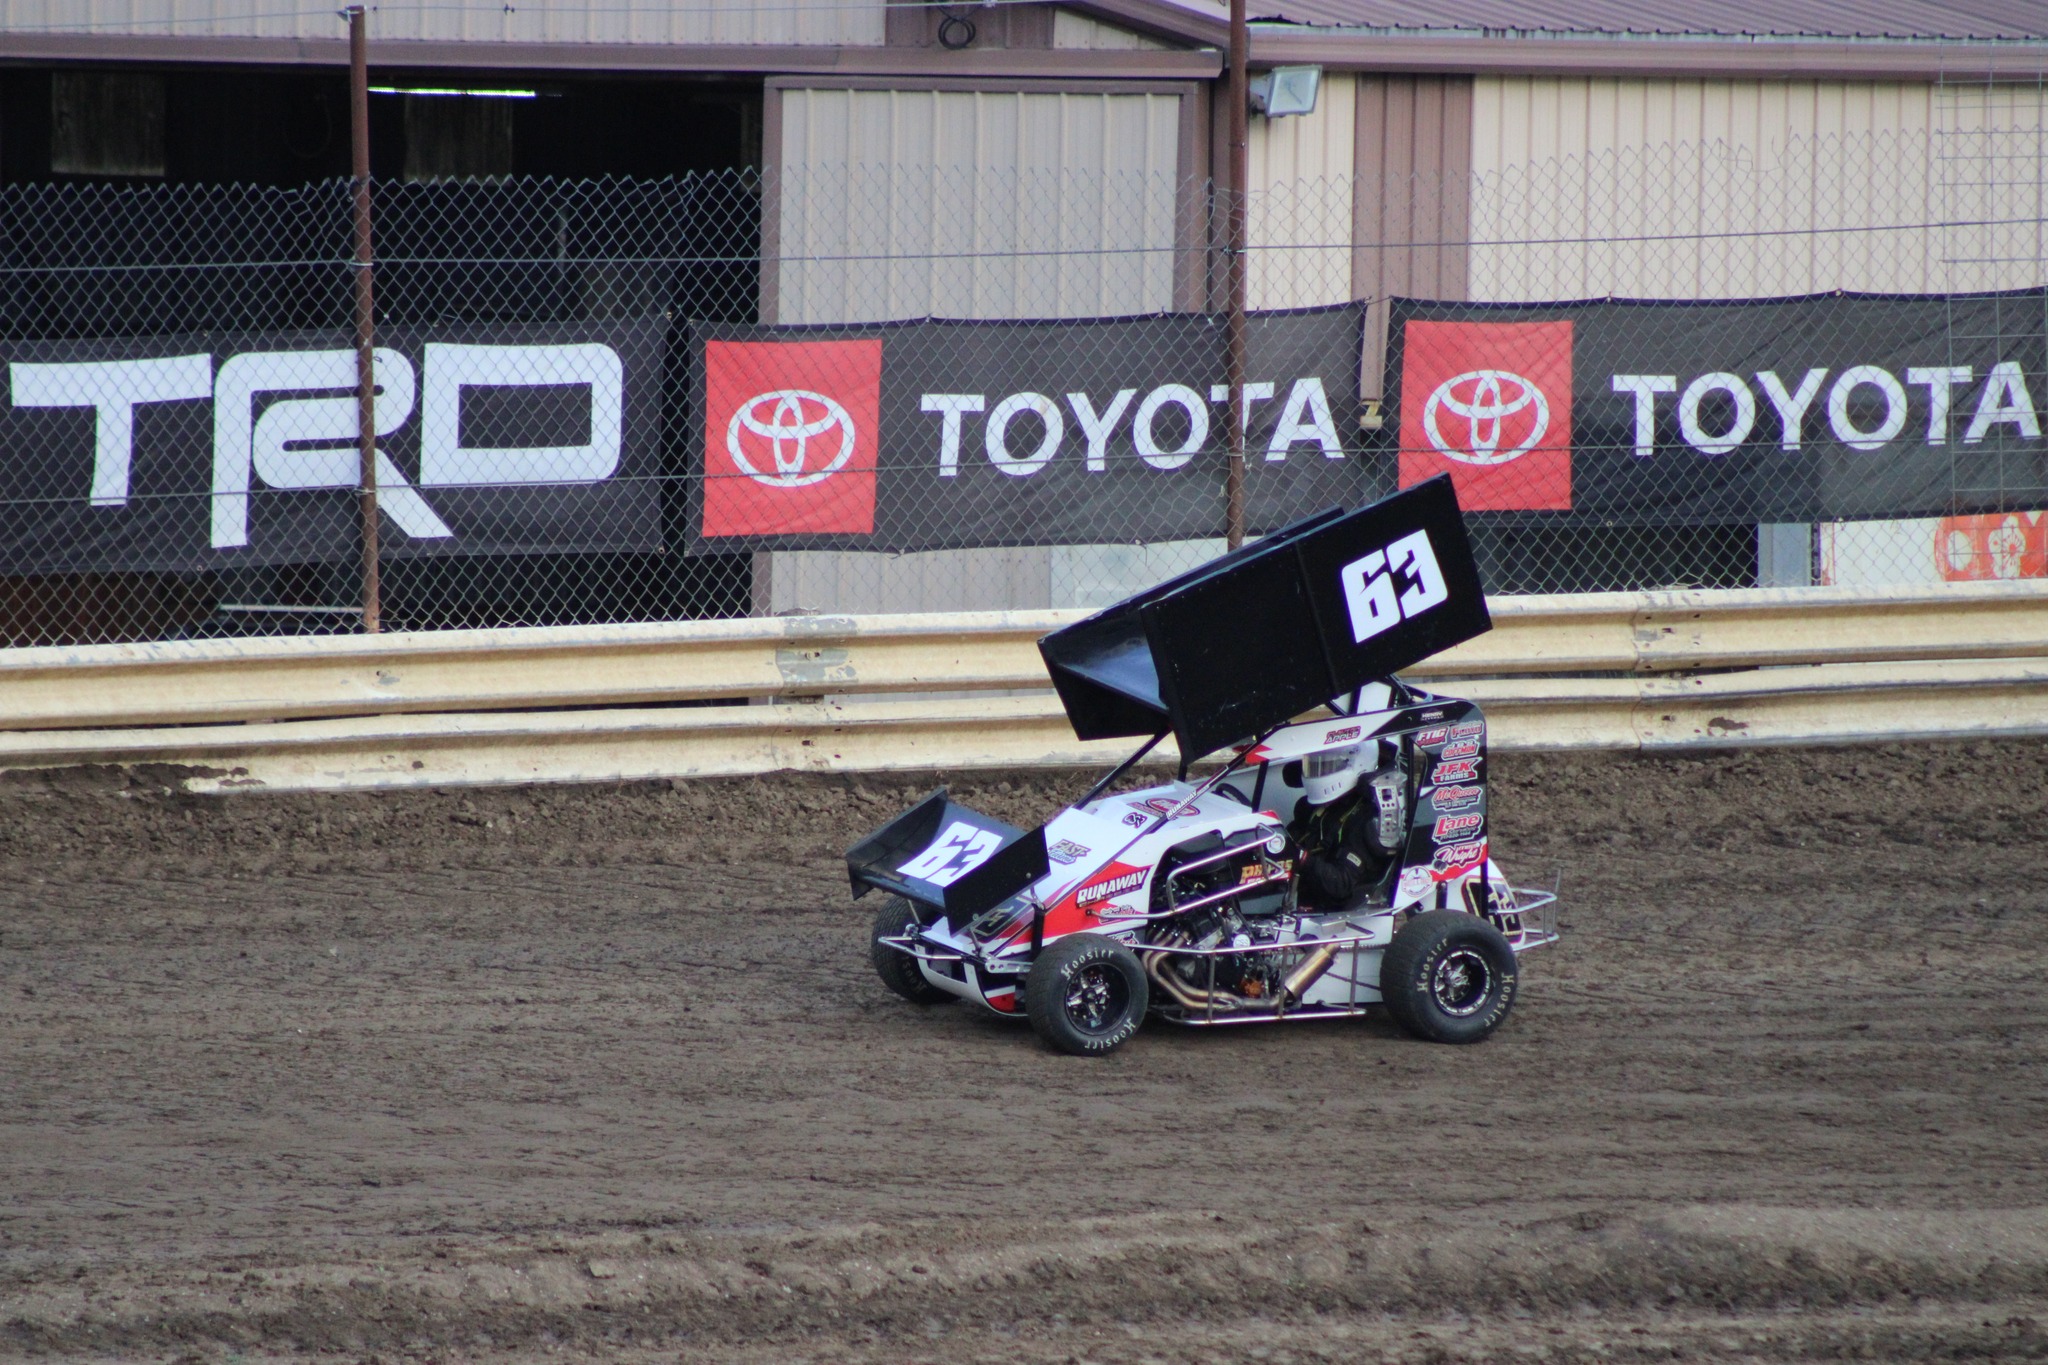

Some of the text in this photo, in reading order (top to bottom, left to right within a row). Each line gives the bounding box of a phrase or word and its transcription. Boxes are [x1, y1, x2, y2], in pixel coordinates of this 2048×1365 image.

[1612, 361, 2042, 456] TOYOTA
[921, 377, 1345, 477] TOYOTA
[10, 342, 623, 548] TRD
[1341, 528, 1448, 643] 63
[1435, 761, 1472, 777] JFK
[1439, 772, 1469, 782] FARMS
[1165, 791, 1197, 818] RUNAWAY
[1436, 814, 1479, 836] Lane
[896, 821, 1003, 888] 63
[1436, 846, 1479, 865] Wright
[1077, 869, 1148, 904] RUNAWAY
[1060, 947, 1114, 980] Hoosier
